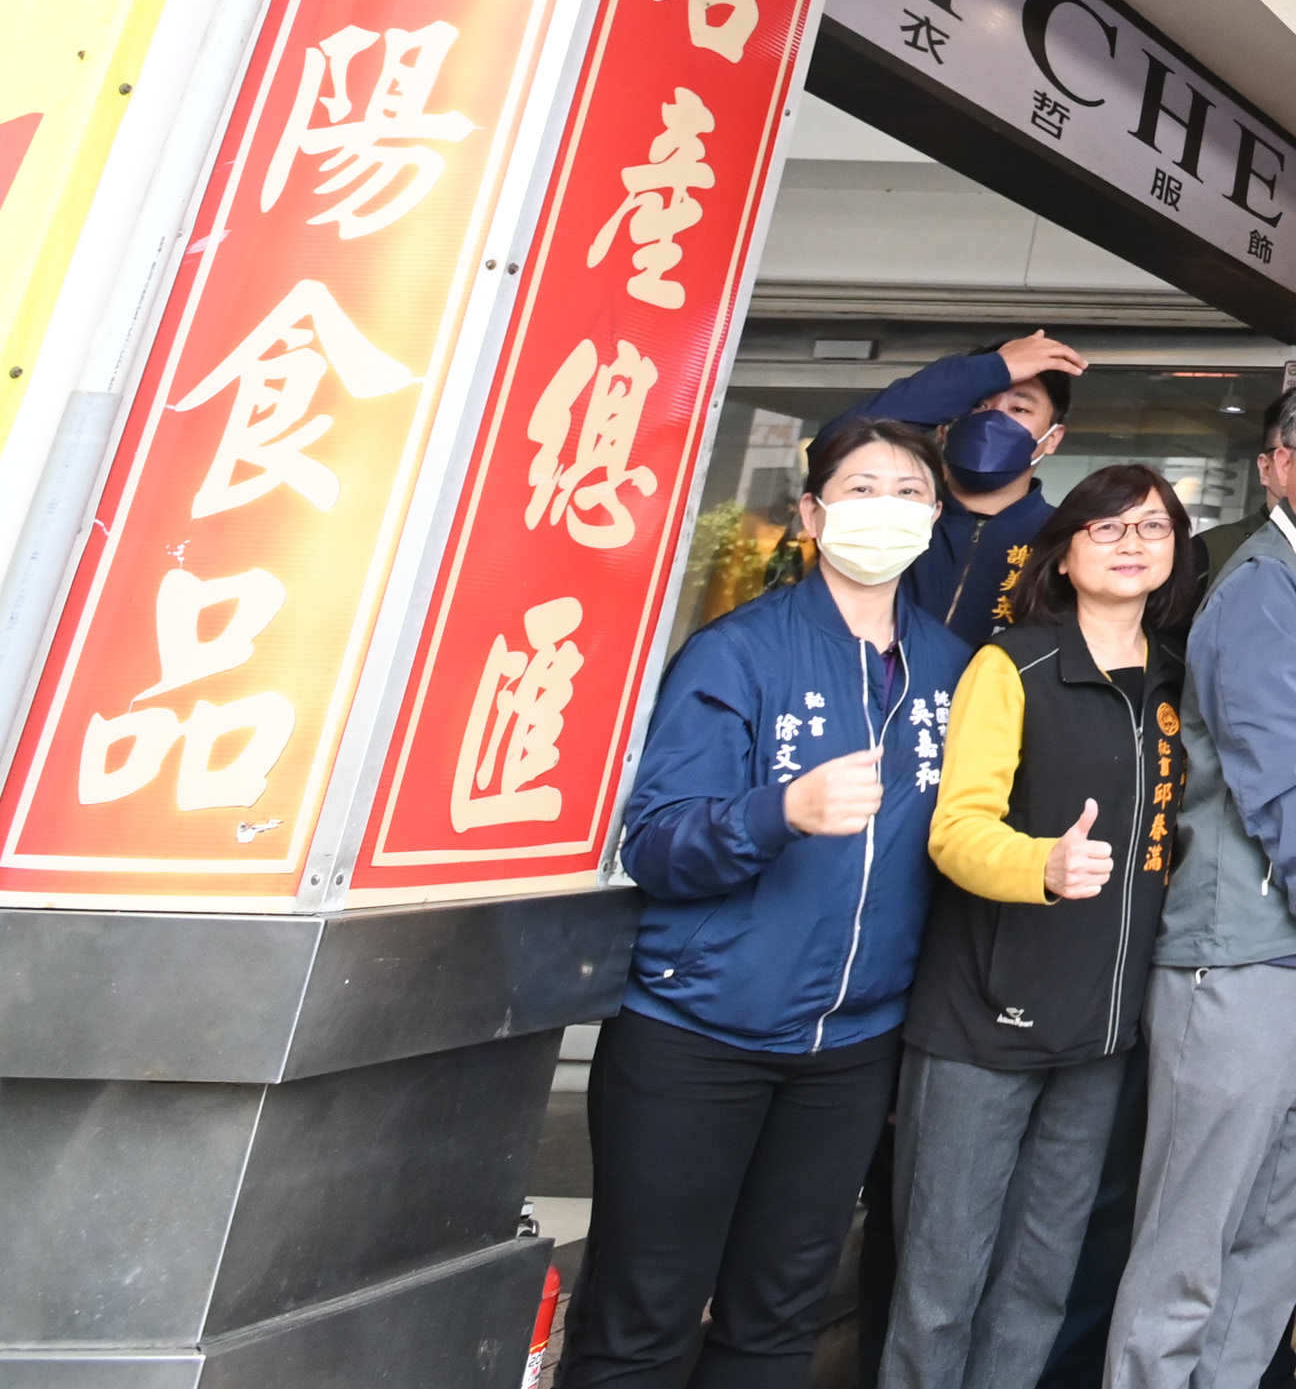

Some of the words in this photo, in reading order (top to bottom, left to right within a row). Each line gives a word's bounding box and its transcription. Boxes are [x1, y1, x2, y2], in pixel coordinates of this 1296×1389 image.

[900, 8, 1274, 265] 衣哲服飾
[772, 713, 803, 783] 徐文
